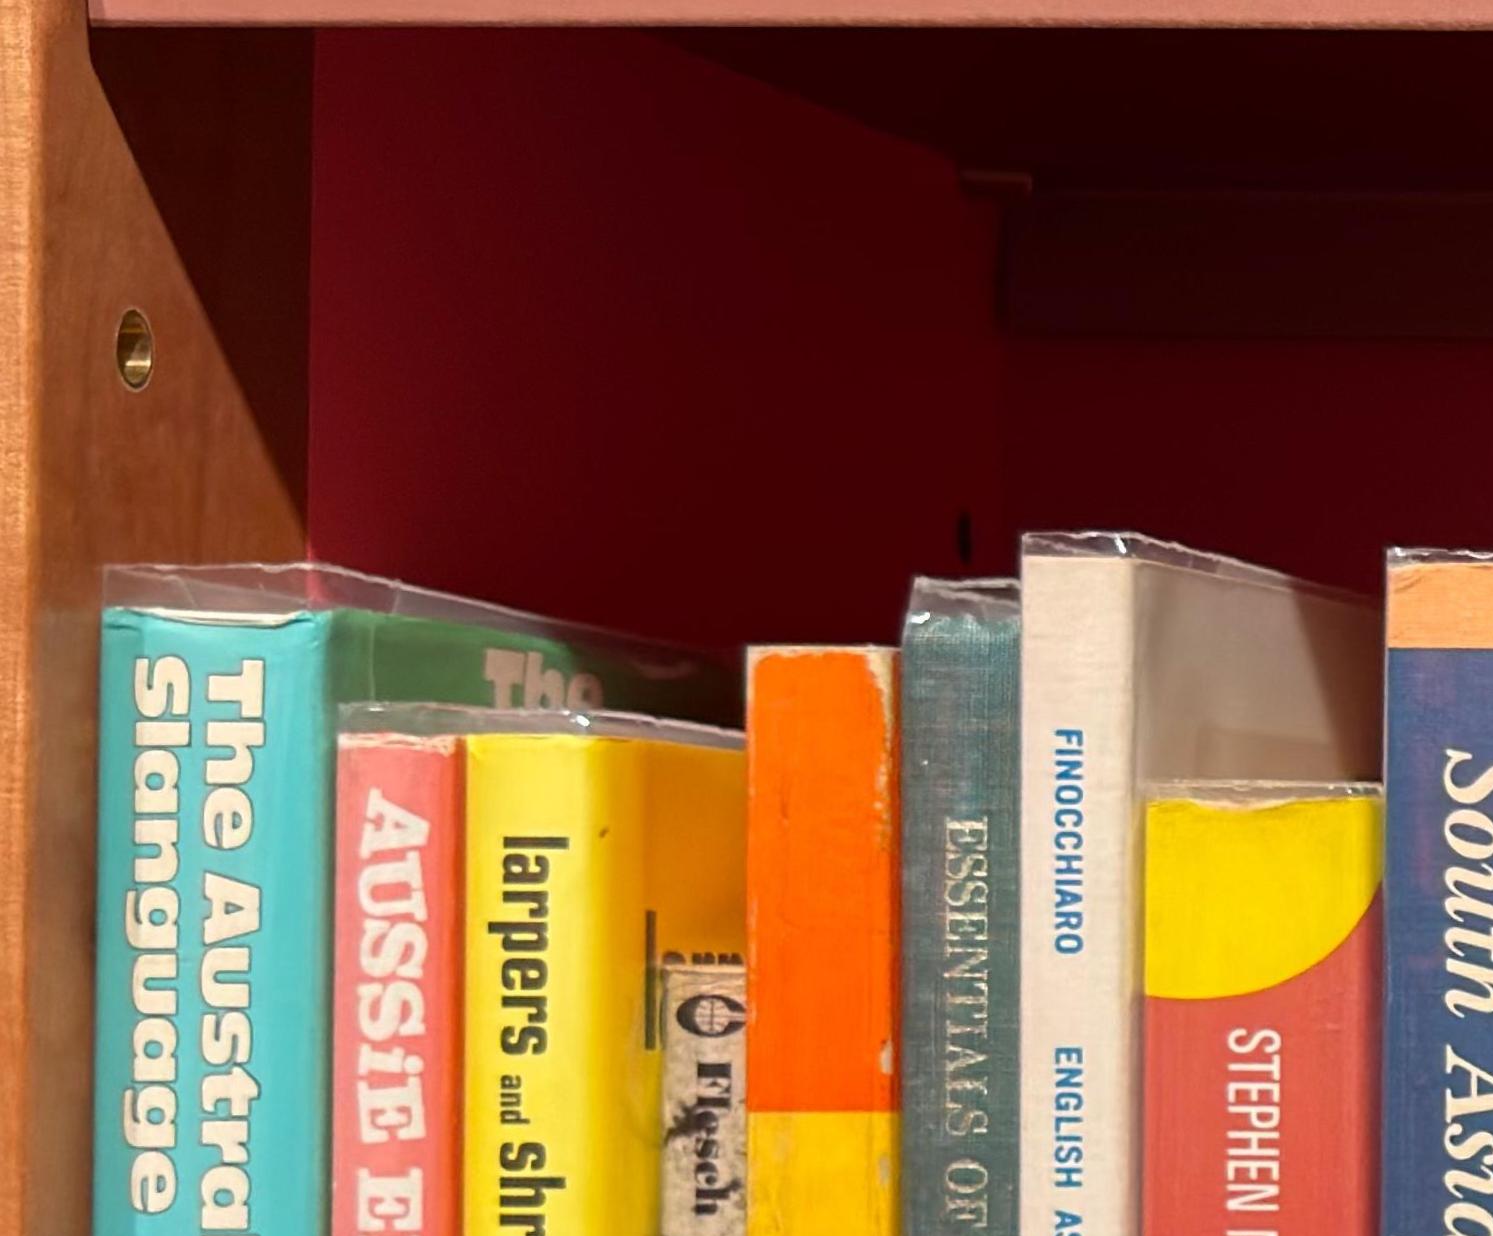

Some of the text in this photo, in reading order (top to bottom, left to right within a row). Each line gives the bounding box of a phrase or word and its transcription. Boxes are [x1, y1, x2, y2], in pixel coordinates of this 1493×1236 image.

[200, 660, 264, 851] The
[1054, 729, 1083, 954] FINOCCHIARO
[121, 654, 191, 1214] Slanguage
[487, 836, 569, 1055] larpers
[944, 816, 989, 1136] ESSENTIALS
[500, 1075, 524, 1125] and
[694, 1061, 731, 1216] Flesch
[945, 1157, 988, 1228] OF
[1054, 1046, 1083, 1188] ENGLISH
[1227, 1028, 1282, 1212] STEPHEN
